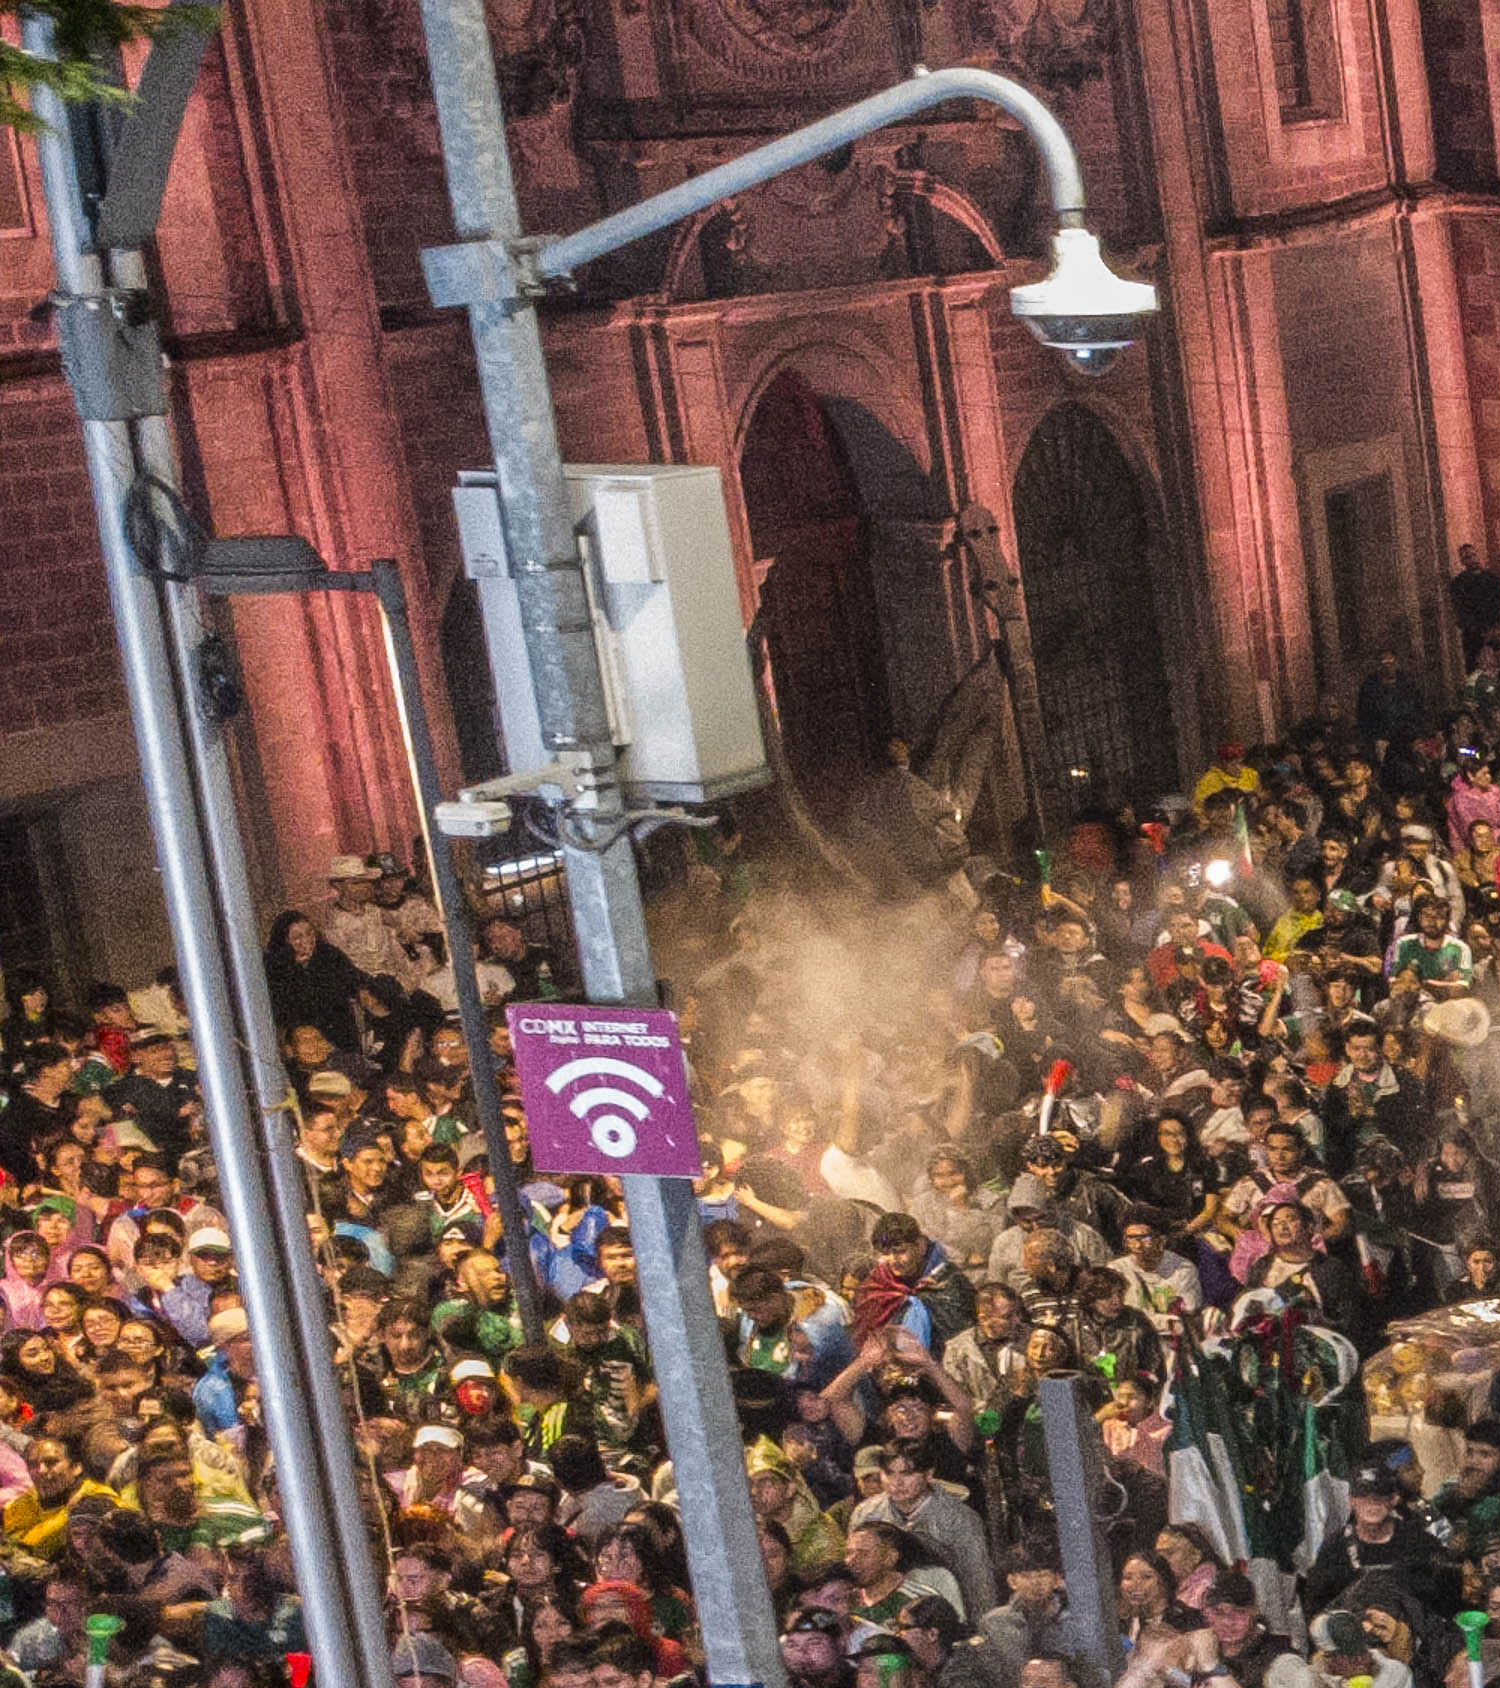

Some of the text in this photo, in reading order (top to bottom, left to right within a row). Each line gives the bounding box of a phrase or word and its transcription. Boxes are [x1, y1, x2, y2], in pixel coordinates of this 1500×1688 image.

[519, 1018, 649, 1035] CDMX INTERNET
[584, 1034, 622, 1046] PARA
[623, 1035, 671, 1047] TODOS
